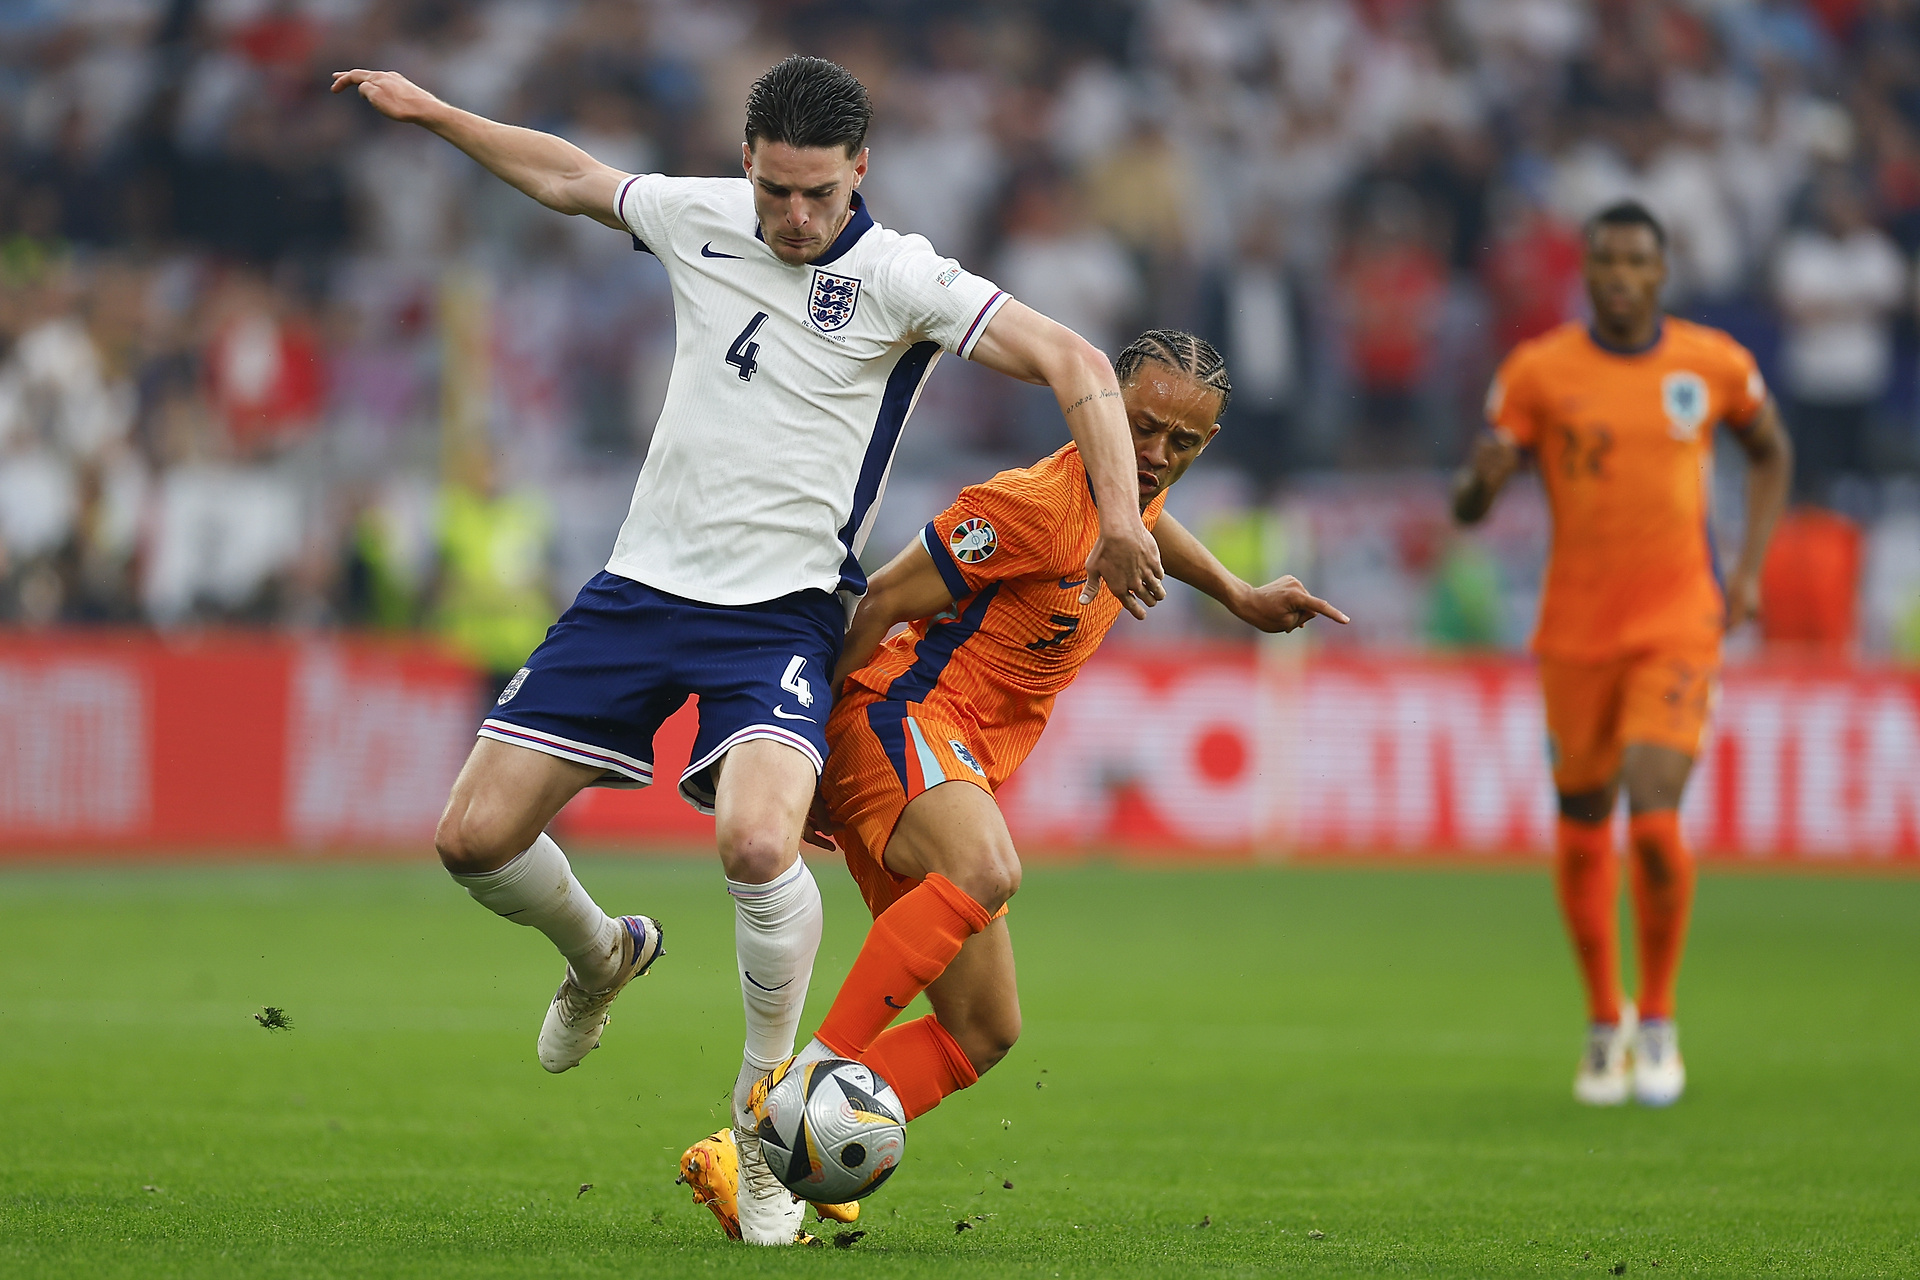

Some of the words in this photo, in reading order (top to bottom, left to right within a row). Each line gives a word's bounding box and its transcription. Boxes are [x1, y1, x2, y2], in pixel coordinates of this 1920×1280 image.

[725, 311, 769, 382] 4
[1025, 614, 1080, 650] 7
[780, 655, 814, 708] 4
